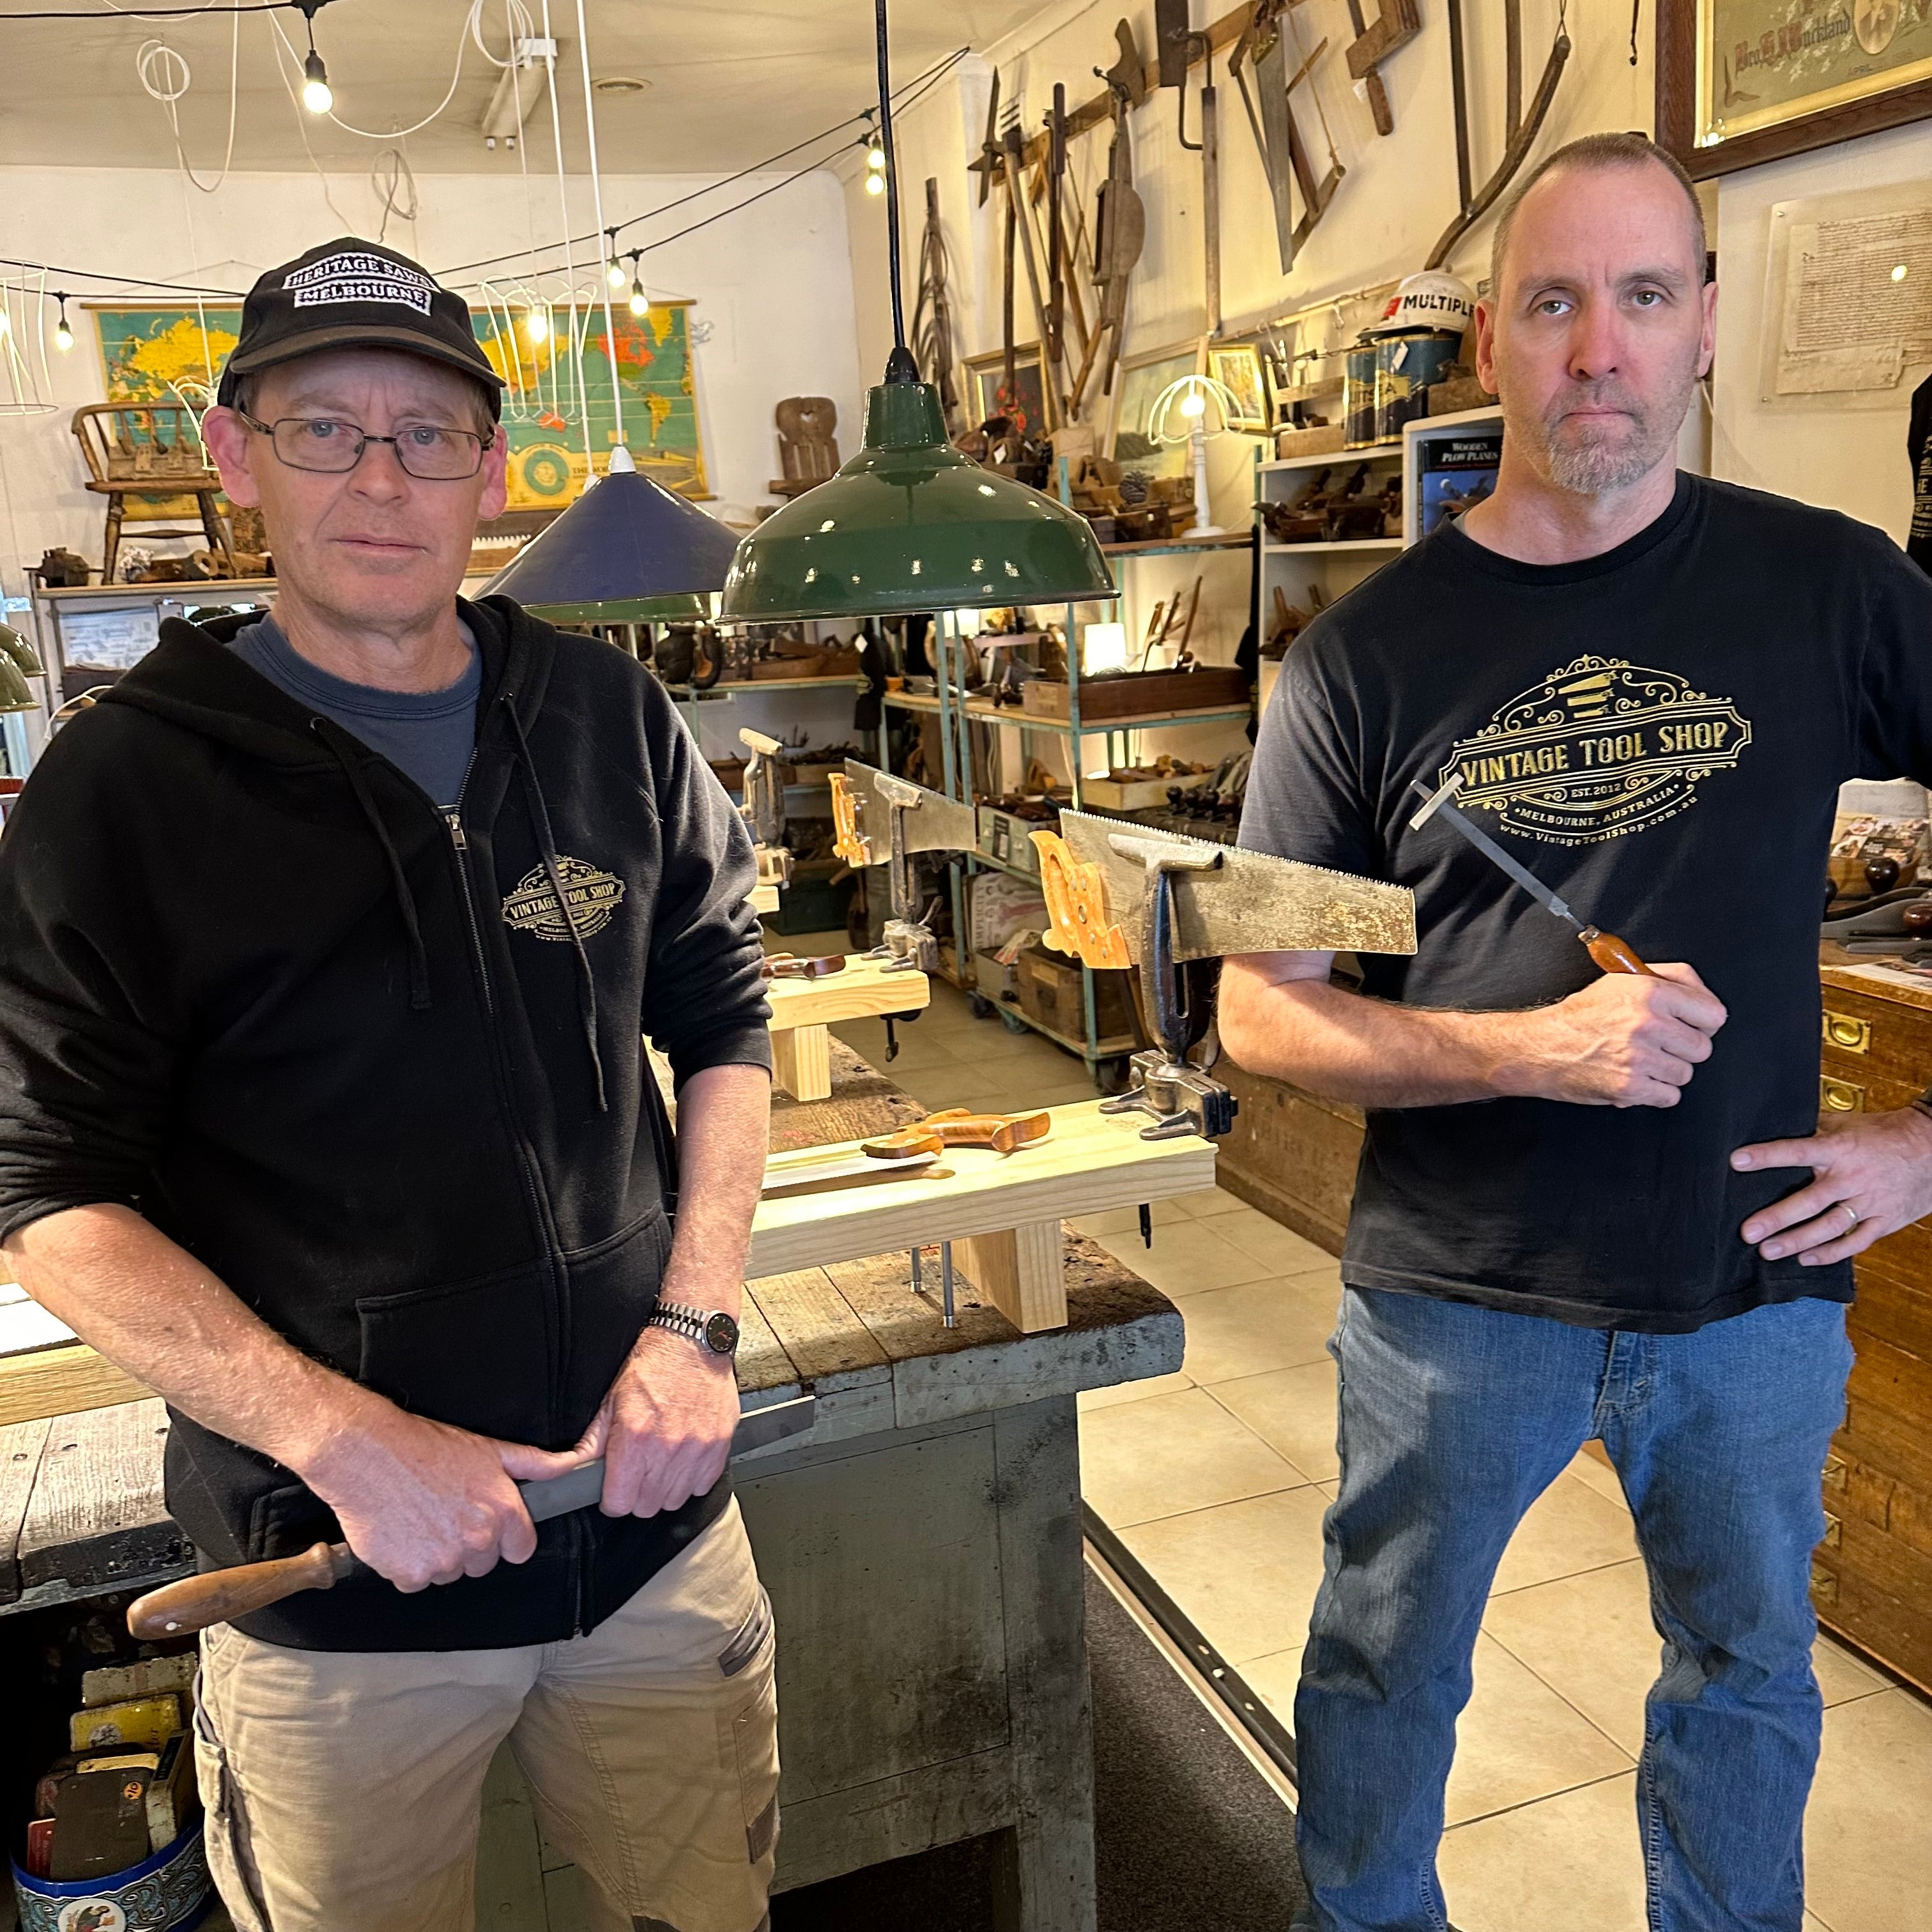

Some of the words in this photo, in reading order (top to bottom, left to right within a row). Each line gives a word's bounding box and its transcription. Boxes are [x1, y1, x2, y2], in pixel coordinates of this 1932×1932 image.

[291, 258, 379, 286] HERITAGE
[383, 263, 429, 288] SAWS
[303, 285, 425, 304] MELBOURNE
[1461, 744, 1570, 786] VINTAGE
[1579, 732, 1648, 766] TOOL
[1659, 721, 1729, 753] SHOP
[1499, 796, 1698, 847] www.VintageToolShop.com.au
[1602, 786, 1675, 823] AUSTRALIA
[510, 895, 560, 919] VINTAGE
[565, 887, 590, 904] OOL
[590, 882, 615, 900] SHOP
